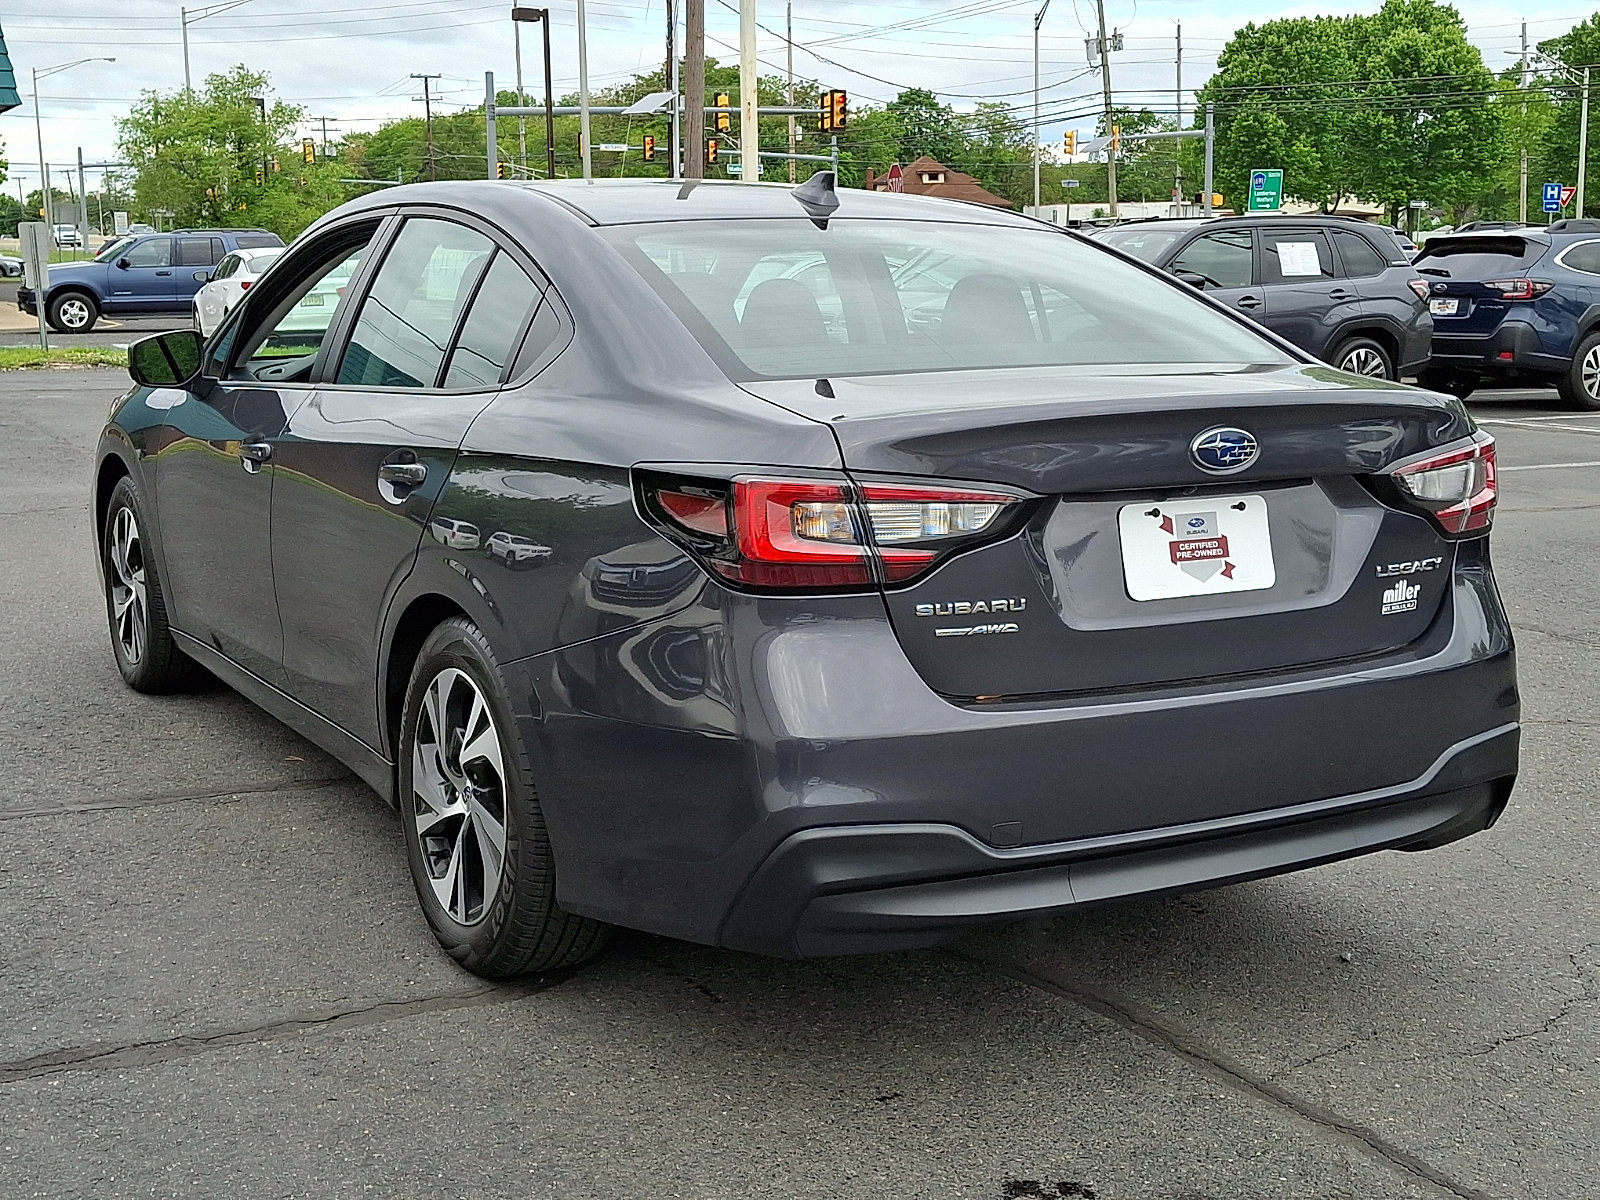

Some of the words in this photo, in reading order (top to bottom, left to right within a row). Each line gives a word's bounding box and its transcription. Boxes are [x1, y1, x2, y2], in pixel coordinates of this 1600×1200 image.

[1546, 186, 1559, 199] H
[1179, 540, 1219, 551] CERTIFIED
[1176, 548, 1224, 559] PRE-OWNED
[1376, 556, 1443, 578] LEGACY
[1382, 579, 1421, 604] miller
[915, 598, 1027, 617] SUBARU
[967, 623, 1020, 636] AWD
